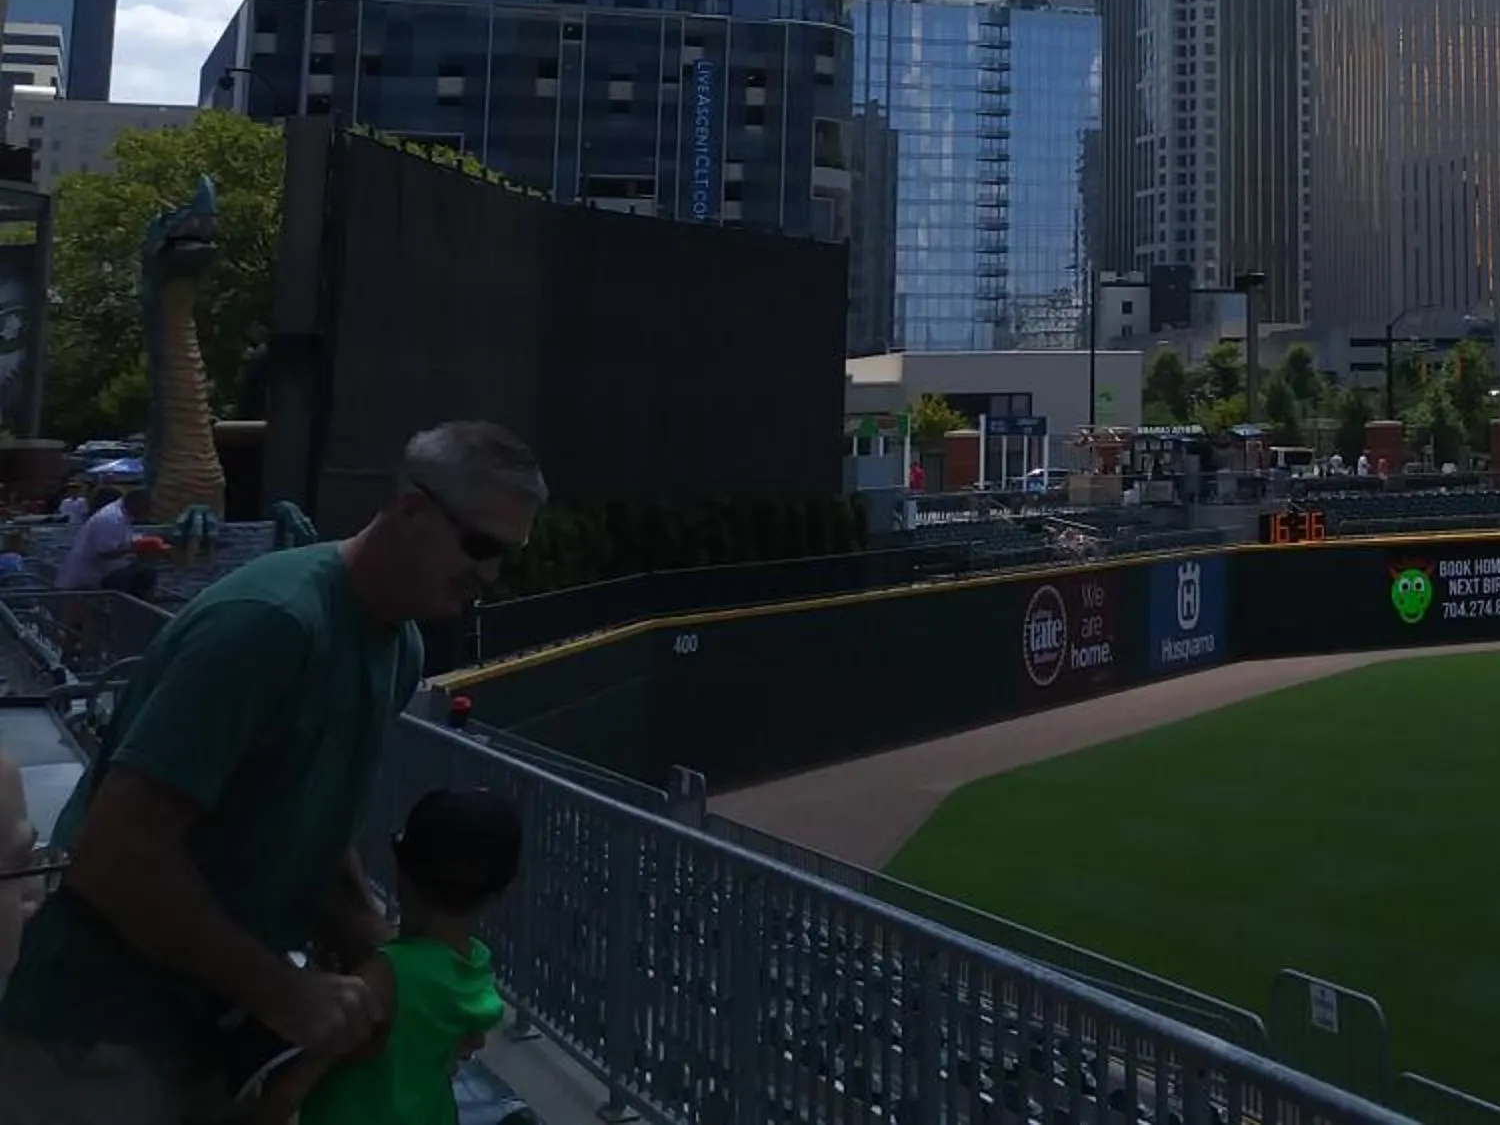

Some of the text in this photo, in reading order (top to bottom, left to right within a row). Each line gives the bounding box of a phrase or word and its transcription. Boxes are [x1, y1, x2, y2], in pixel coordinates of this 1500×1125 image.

[1439, 560, 1471, 577] BOOK
[1081, 583, 1104, 609] We
[1449, 578, 1480, 596] NEXT
[1081, 615, 1103, 639] are
[673, 634, 699, 654] 400
